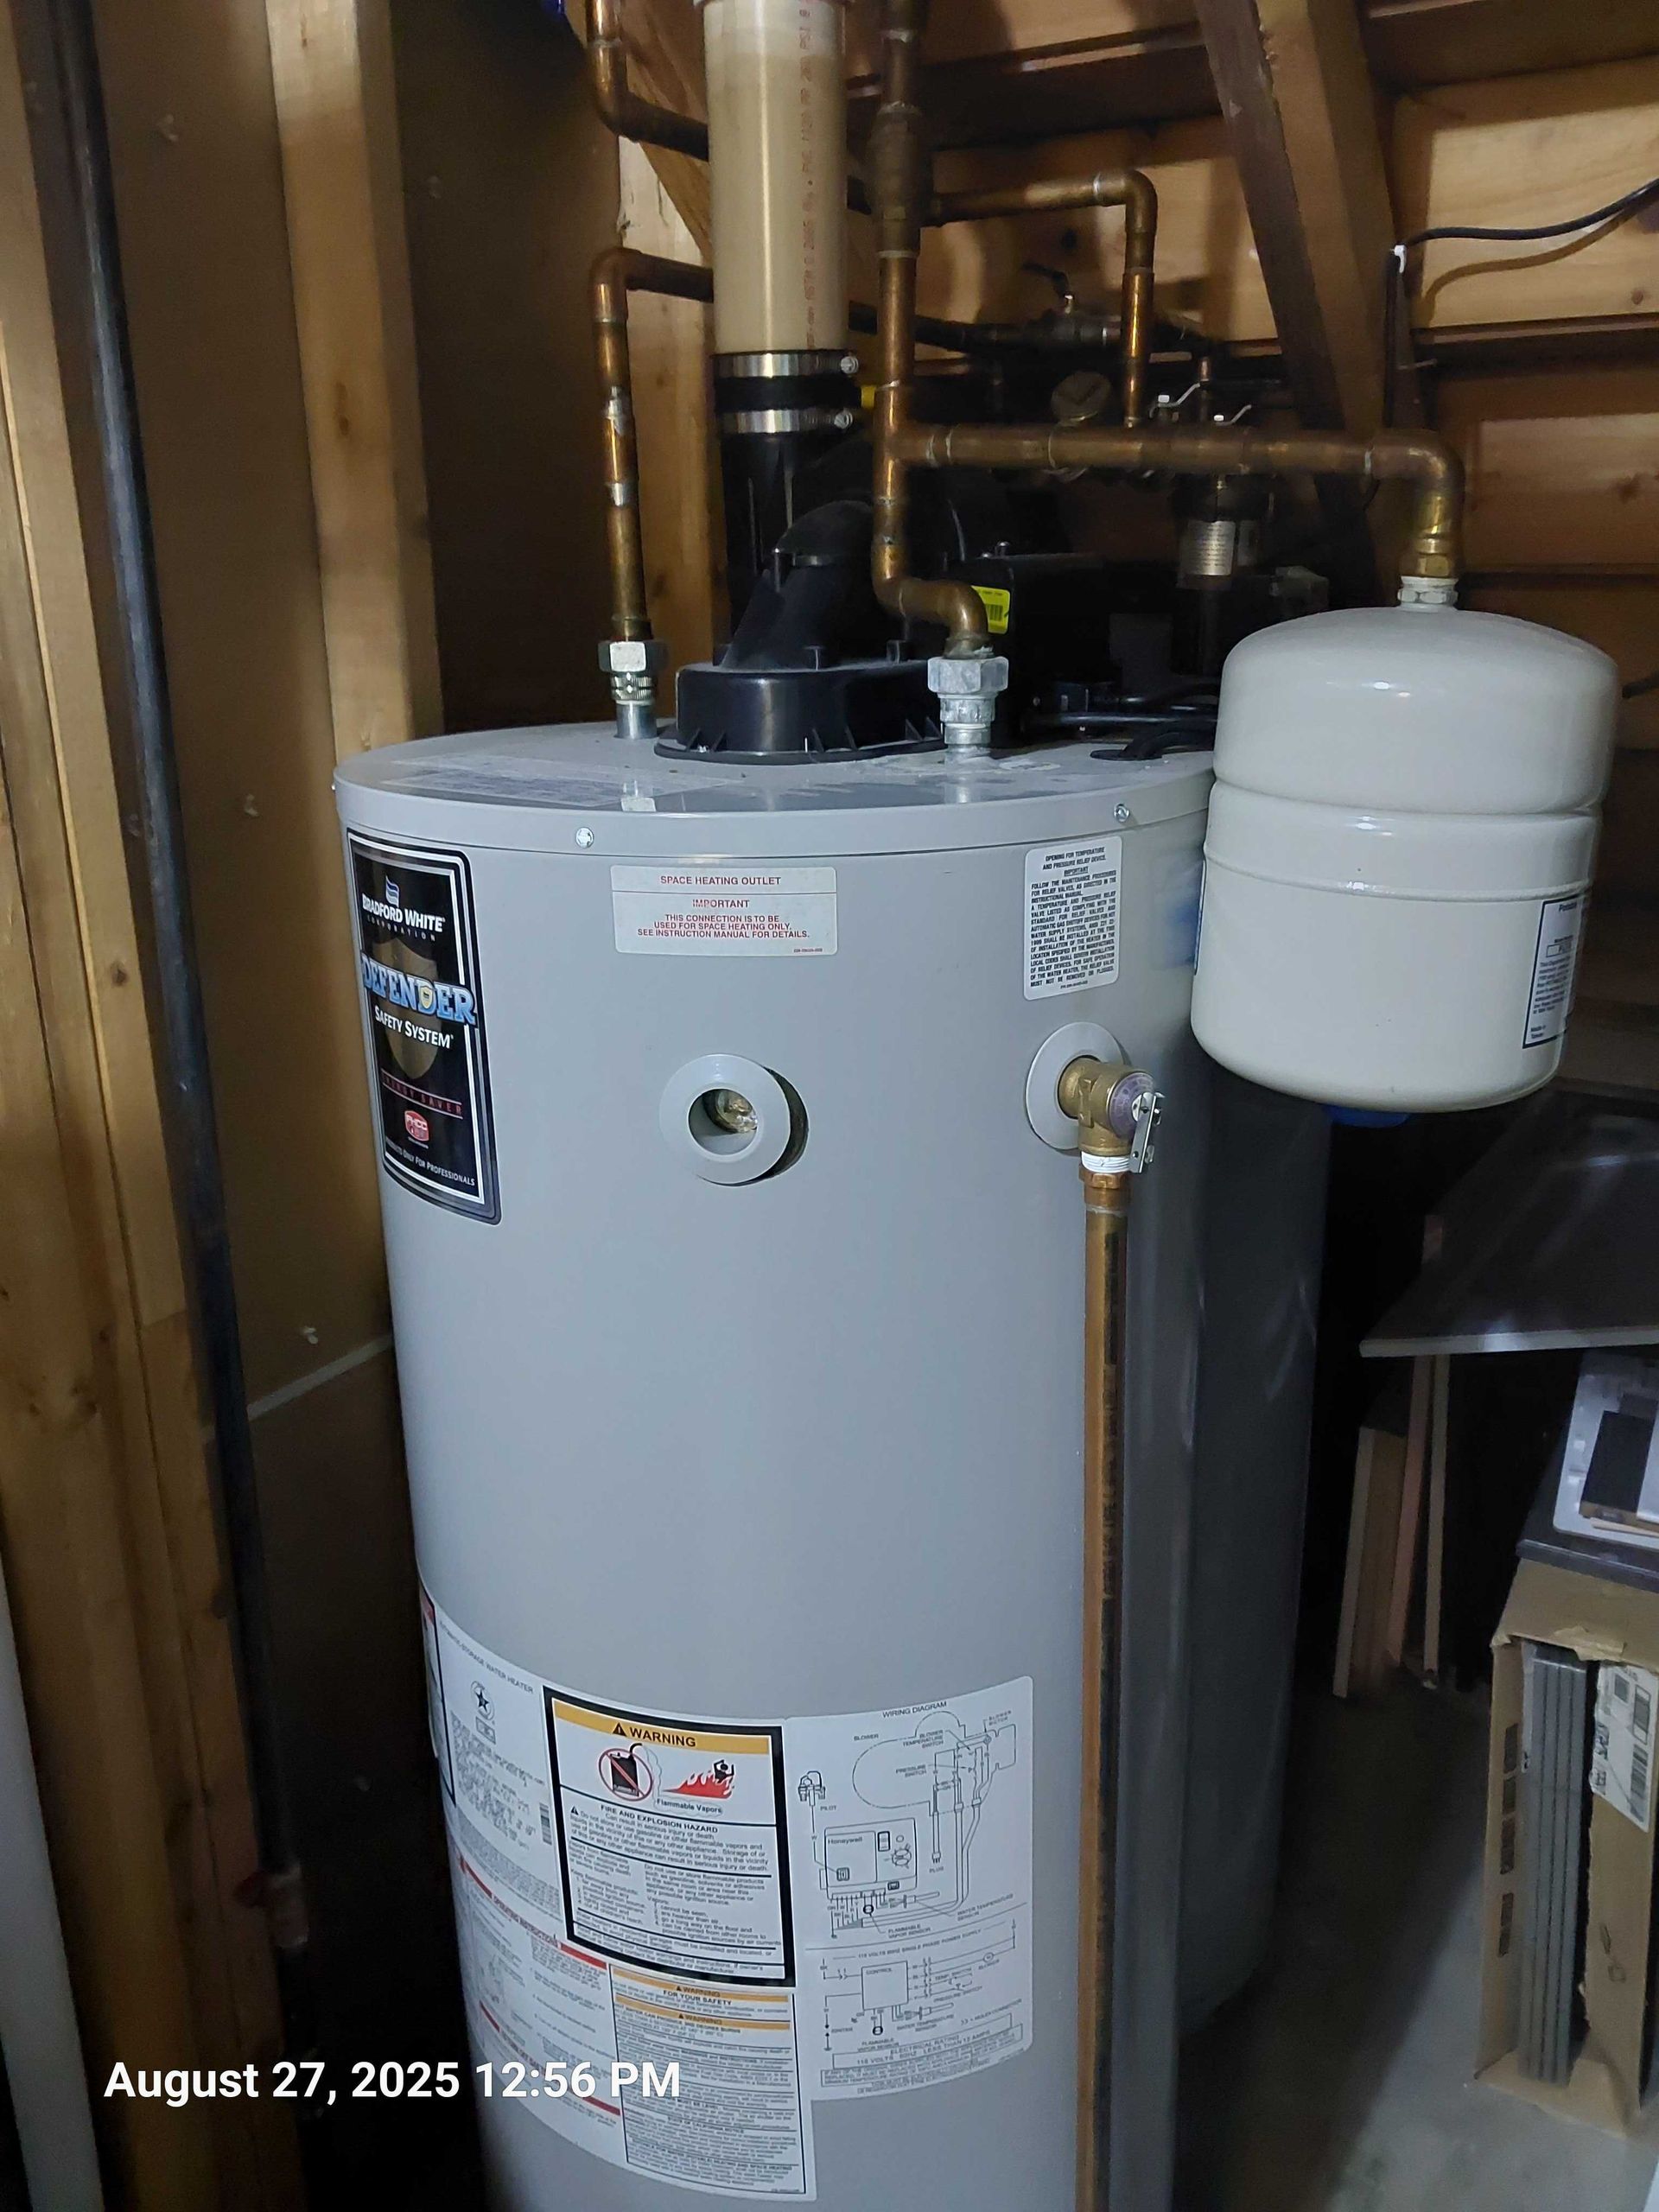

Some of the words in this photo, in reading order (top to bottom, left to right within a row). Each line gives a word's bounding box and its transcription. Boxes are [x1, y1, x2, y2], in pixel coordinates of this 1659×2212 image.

[1075, 847, 1104, 857] TEMPERATURE
[1053, 860, 1076, 869] PRESSURE
[1064, 866, 1089, 876] IMPORTANT
[660, 875, 692, 885] SPACE
[695, 876, 739, 886] HEATING
[741, 876, 781, 886] OUTLET
[1031, 881, 1049, 890] FOLLOW
[1061, 874, 1090, 885] MAINTENANCE
[692, 899, 750, 908] IMPORTANT
[1031, 893, 1064, 904] INSTRUCTIONAL
[1038, 899, 1067, 910] TEMPERATURE
[1082, 893, 1101, 902] PRESSURE
[362, 893, 403, 923] BRADFORD
[1031, 910, 1045, 918] VALVE
[1046, 907, 1062, 916] LISTED
[1071, 901, 1095, 912] COMPLYING
[686, 914, 742, 923] CONNECTION
[1031, 916, 1055, 925] STANDARD
[1071, 910, 1085, 918] RELIEF
[1089, 906, 1104, 915] VALVES
[366, 914, 435, 942] CORPORATION
[698, 922, 726, 931] SPACE
[766, 922, 792, 931] ONLY.
[1031, 923, 1056, 932] AUTOMATIC
[1084, 915, 1100, 924] DEVICES
[655, 929, 711, 938] INSTRUCTION
[713, 930, 750, 938] MANUAL
[752, 930, 770, 938] FOR
[772, 930, 810, 938] DETAILS.
[1031, 931, 1046, 939] WATER
[1048, 928, 1065, 937] SUPPLY
[1044, 936, 1057, 944] SHALL
[1066, 931, 1089, 940] INSTALLED
[1031, 951, 1050, 960] LOCATION
[1051, 947, 1071, 957] SPECIFIED
[1038, 942, 1068, 952] INSTALLATION
[1090, 945, 1115, 956] INSTALLATION
[1094, 951, 1115, 961] OPERATION
[1046, 969, 1062, 978] WATER
[1089, 961, 1102, 969] RELIEF
[1066, 972, 1085, 981] REMOVED
[360, 955, 476, 1026] DEFENDER
[374, 1005, 403, 1033] SAFETY
[404, 1020, 450, 1049] SYSTEM
[420, 1093, 462, 1115] SAVER
[416, 1156, 426, 1168] FOR
[427, 1161, 475, 1186] PROFESSIONALS
[507, 1676, 533, 1694] HEATER
[882, 1707, 911, 1719] WIRING
[912, 1700, 947, 1714] DIAGRAM
[629, 1726, 696, 1748] WARNING
[919, 1729, 944, 1738] BLOWER
[903, 1735, 944, 1747] TEMPERATURE
[657, 1798, 695, 1812] Flammable
[696, 1802, 722, 1815] Vapors
[601, 1804, 617, 1814] FIRE
[619, 1810, 635, 1820] AND
[637, 1815, 683, 1828] EXPLOSION
[683, 1822, 718, 1833] HAZARD
[668, 1828, 685, 1838] injury
[690, 1838, 724, 1848] flammable
[726, 1842, 748, 1851] vapors
[671, 1850, 693, 1859] vapors
[702, 1853, 724, 1863] liquids
[747, 1858, 769, 1866] vicinity
[722, 1849, 749, 1858] Storage
[695, 1860, 718, 1869] serious
[720, 1863, 737, 1872] injury
[683, 1986, 721, 1998] WARNING
[681, 1993, 702, 2002] YOUR
[703, 1997, 733, 2005] SAFETY
[685, 2014, 722, 2026] WARNING
[870, 2055, 894, 2064] VOLTS
[971, 2031, 990, 2042] AMPS
[890, 2041, 933, 2055] ELECTRICAL
[934, 2034, 960, 2046] RATING
